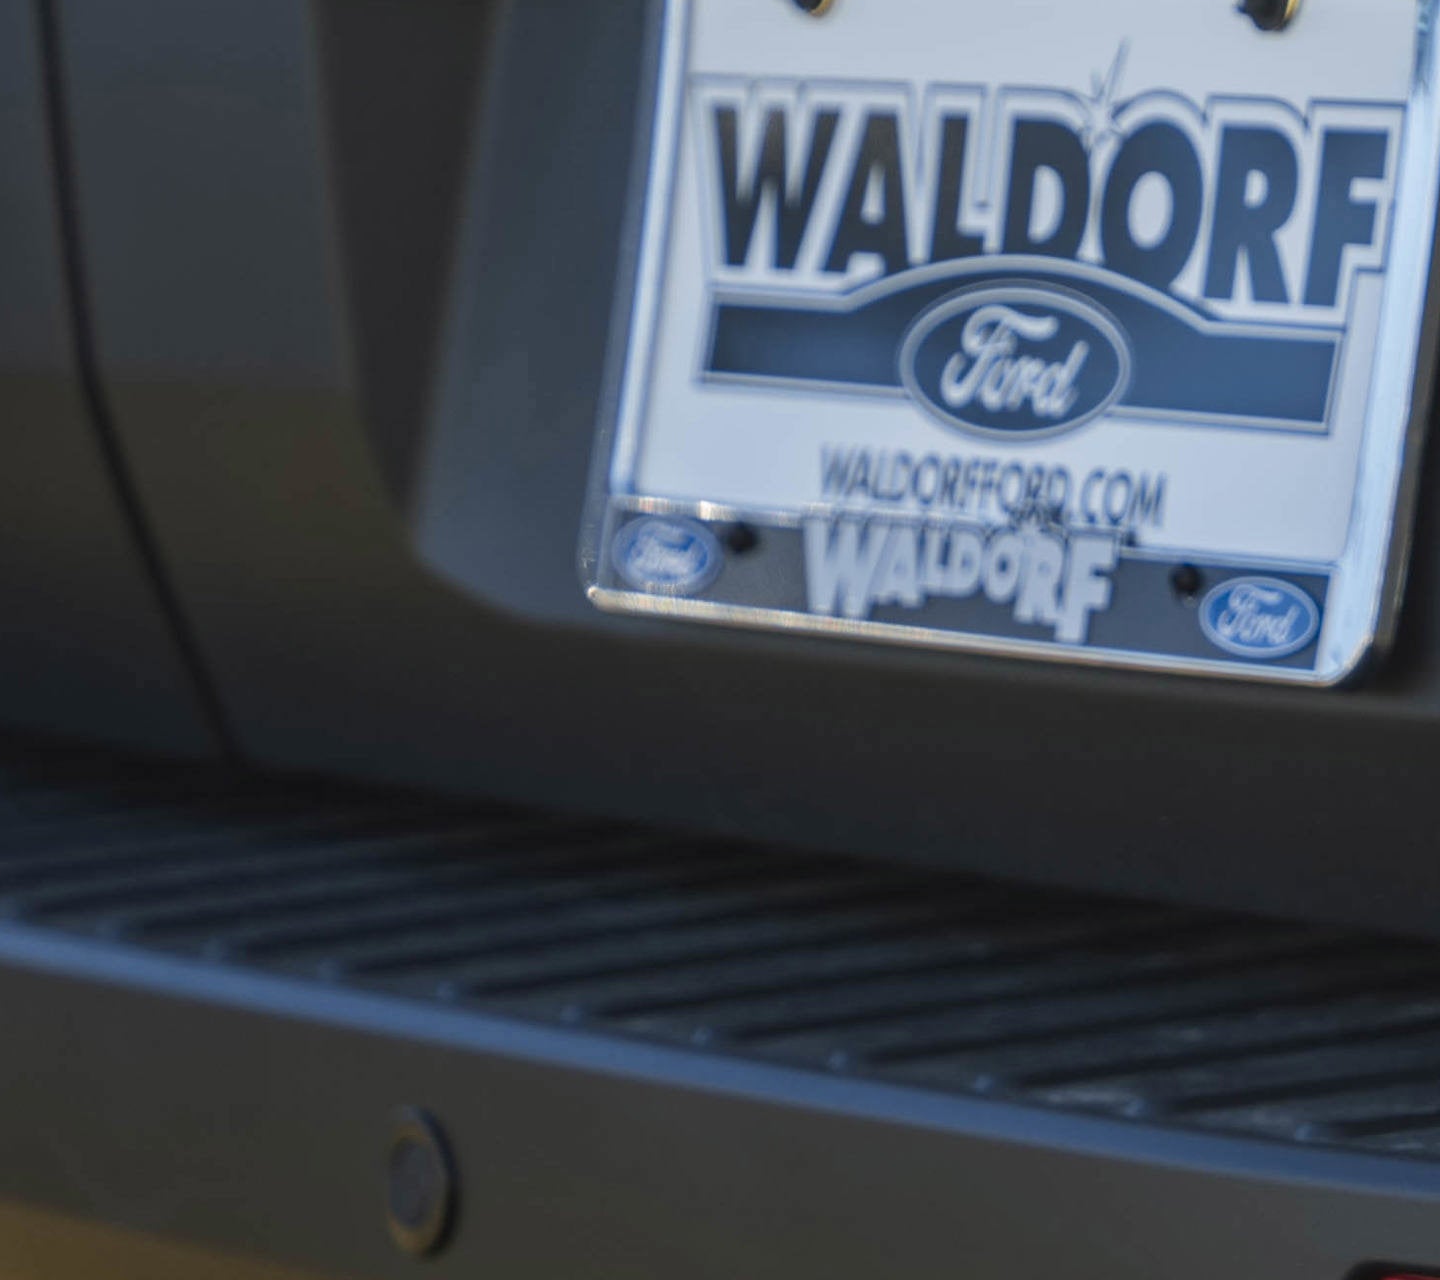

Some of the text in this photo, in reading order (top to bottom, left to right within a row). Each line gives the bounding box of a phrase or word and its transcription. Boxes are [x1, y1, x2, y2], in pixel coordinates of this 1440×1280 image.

[698, 88, 1398, 312] WALDORF
[940, 303, 1090, 418] Ford
[819, 442, 1168, 528] WALDORFFORD.COM
[804, 517, 1118, 646] WALDORF
[1216, 583, 1300, 645] Ford
